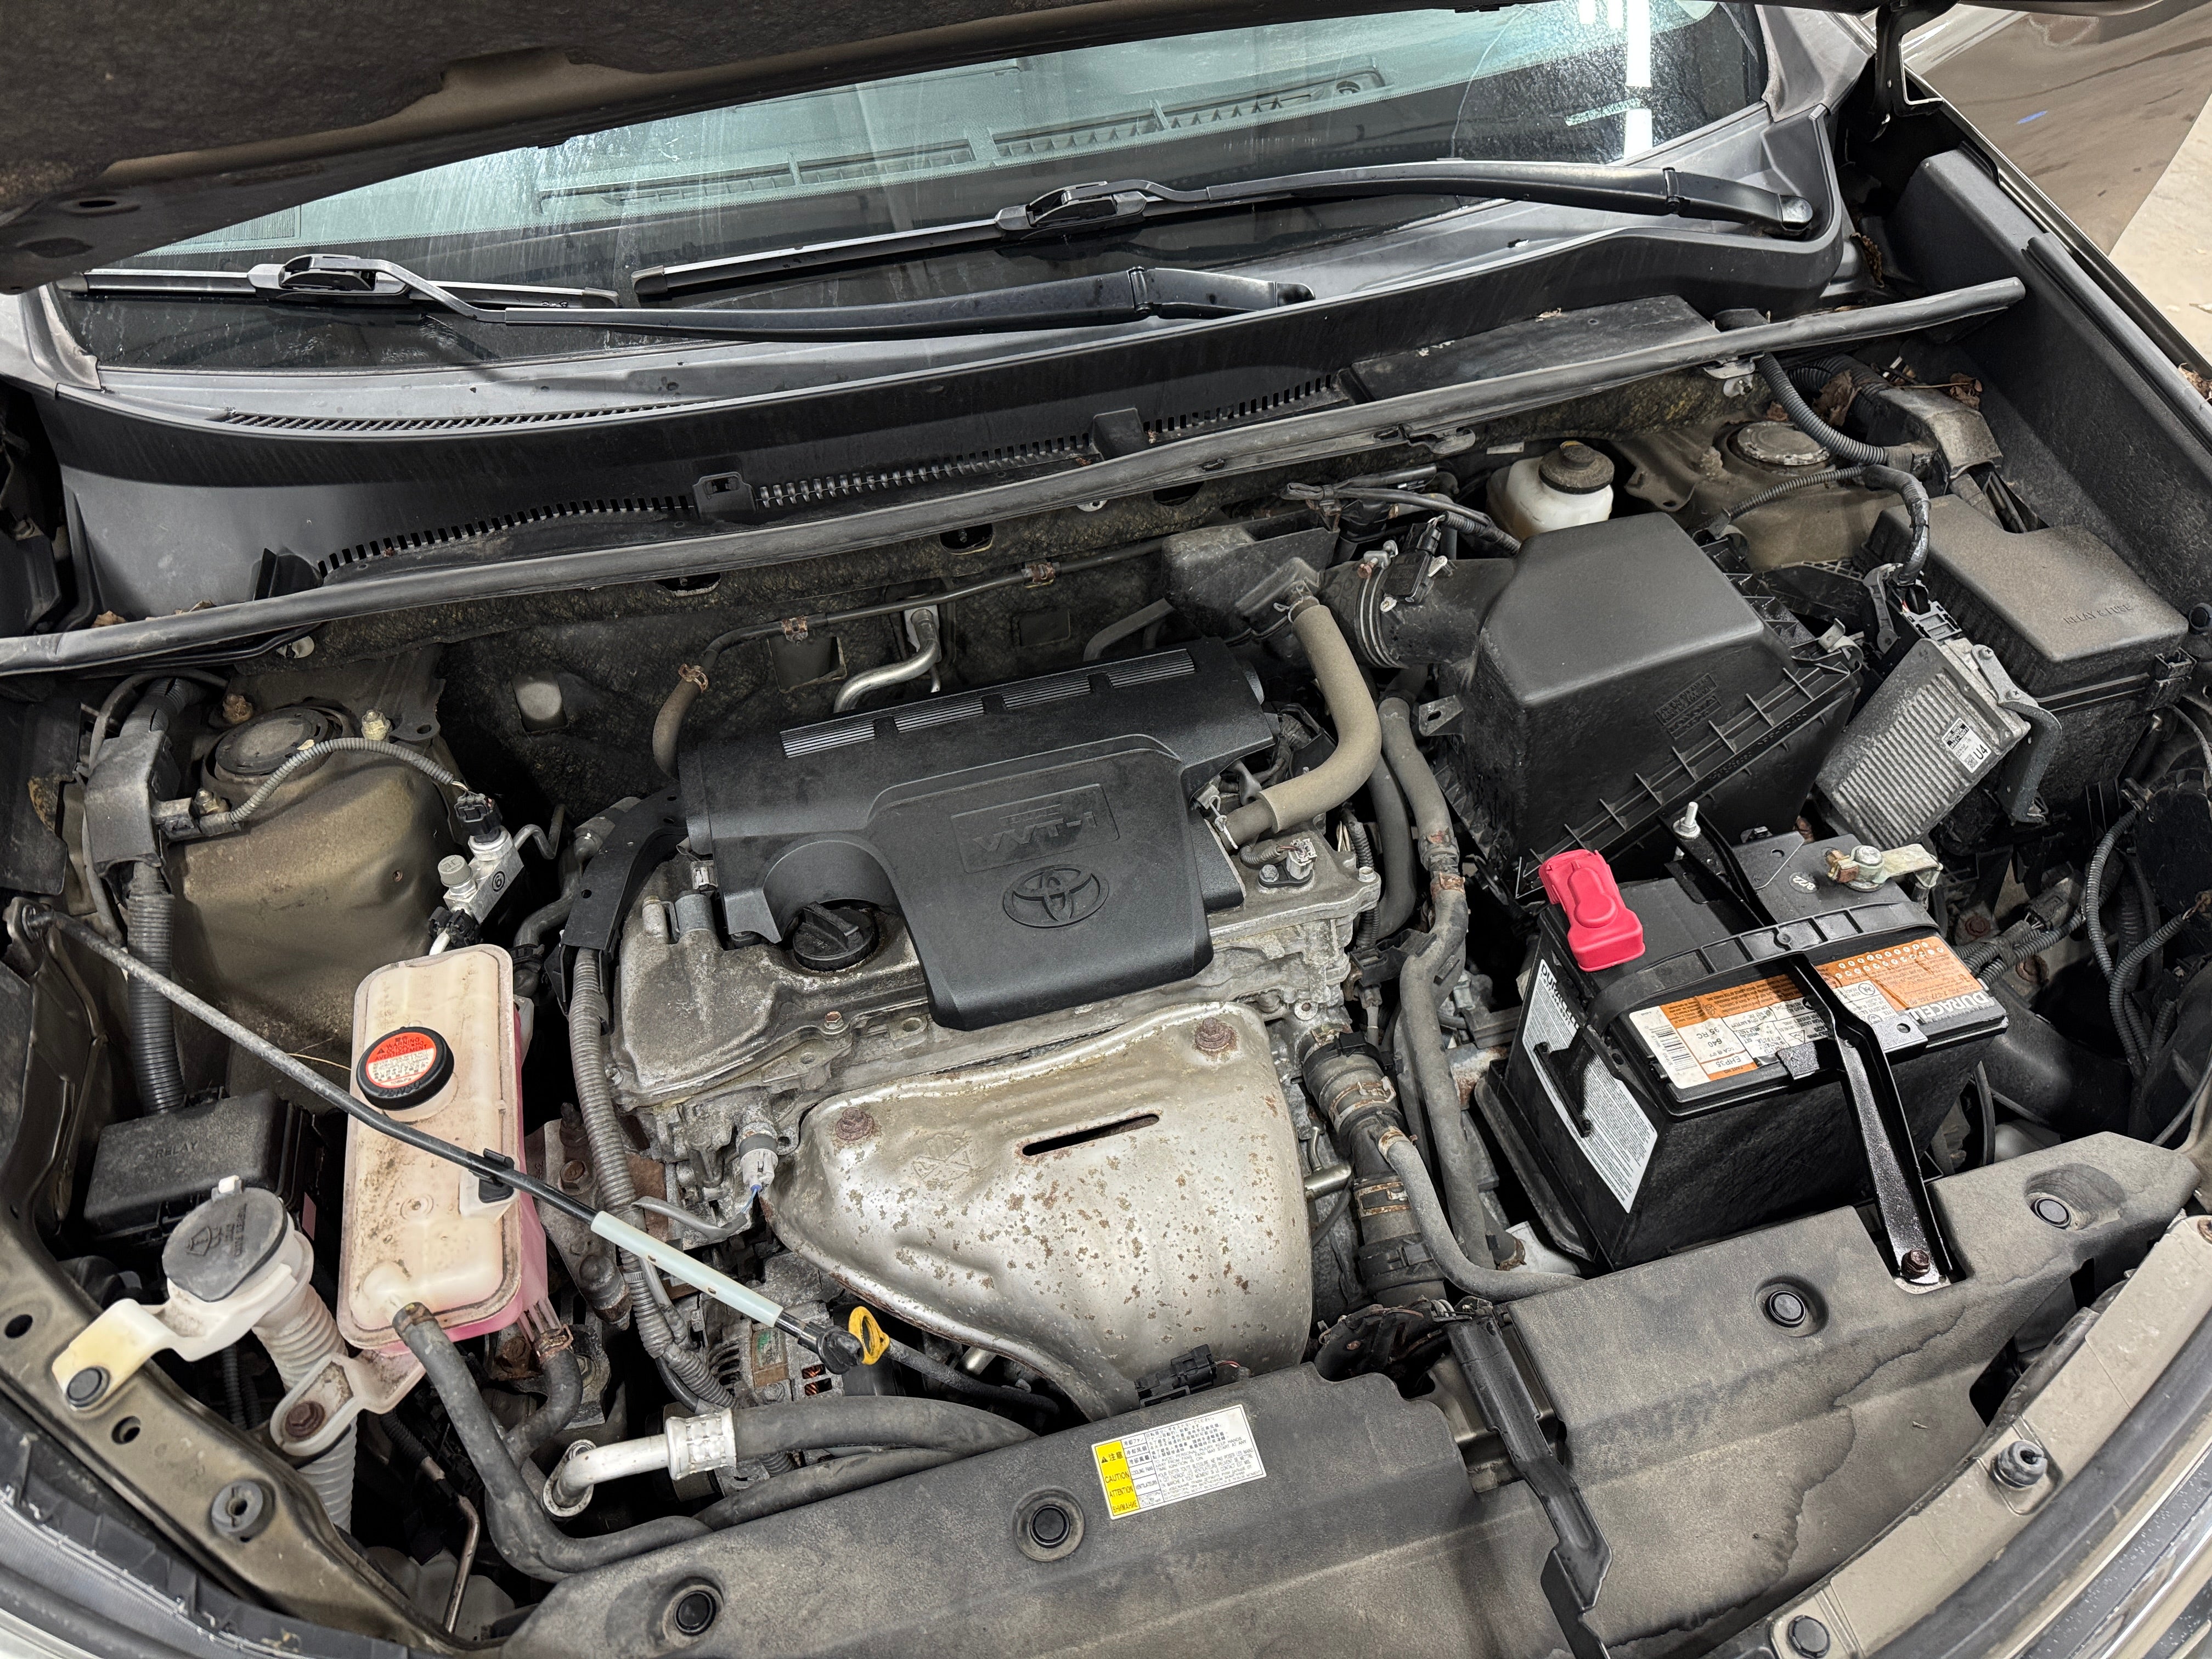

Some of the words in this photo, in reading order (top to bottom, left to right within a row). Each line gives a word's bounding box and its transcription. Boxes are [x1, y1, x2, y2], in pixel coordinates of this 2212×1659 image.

[2063, 612, 2097, 625] RELAY
[1973, 744, 1988, 760] U4
[1904, 991, 1989, 1022] DURACELL
[386, 1037, 420, 1049] WARNING
[1707, 1038, 1722, 1047] 640
[375, 1045, 427, 1060] AVERTISSEMENT
[1715, 1056, 1741, 1066] EHP35
[156, 1140, 199, 1158] RELAY
[1108, 1450, 1123, 1462] 注意
[1104, 1470, 1130, 1483] CAUTION
[1108, 1485, 1133, 1498] ATTENTION
